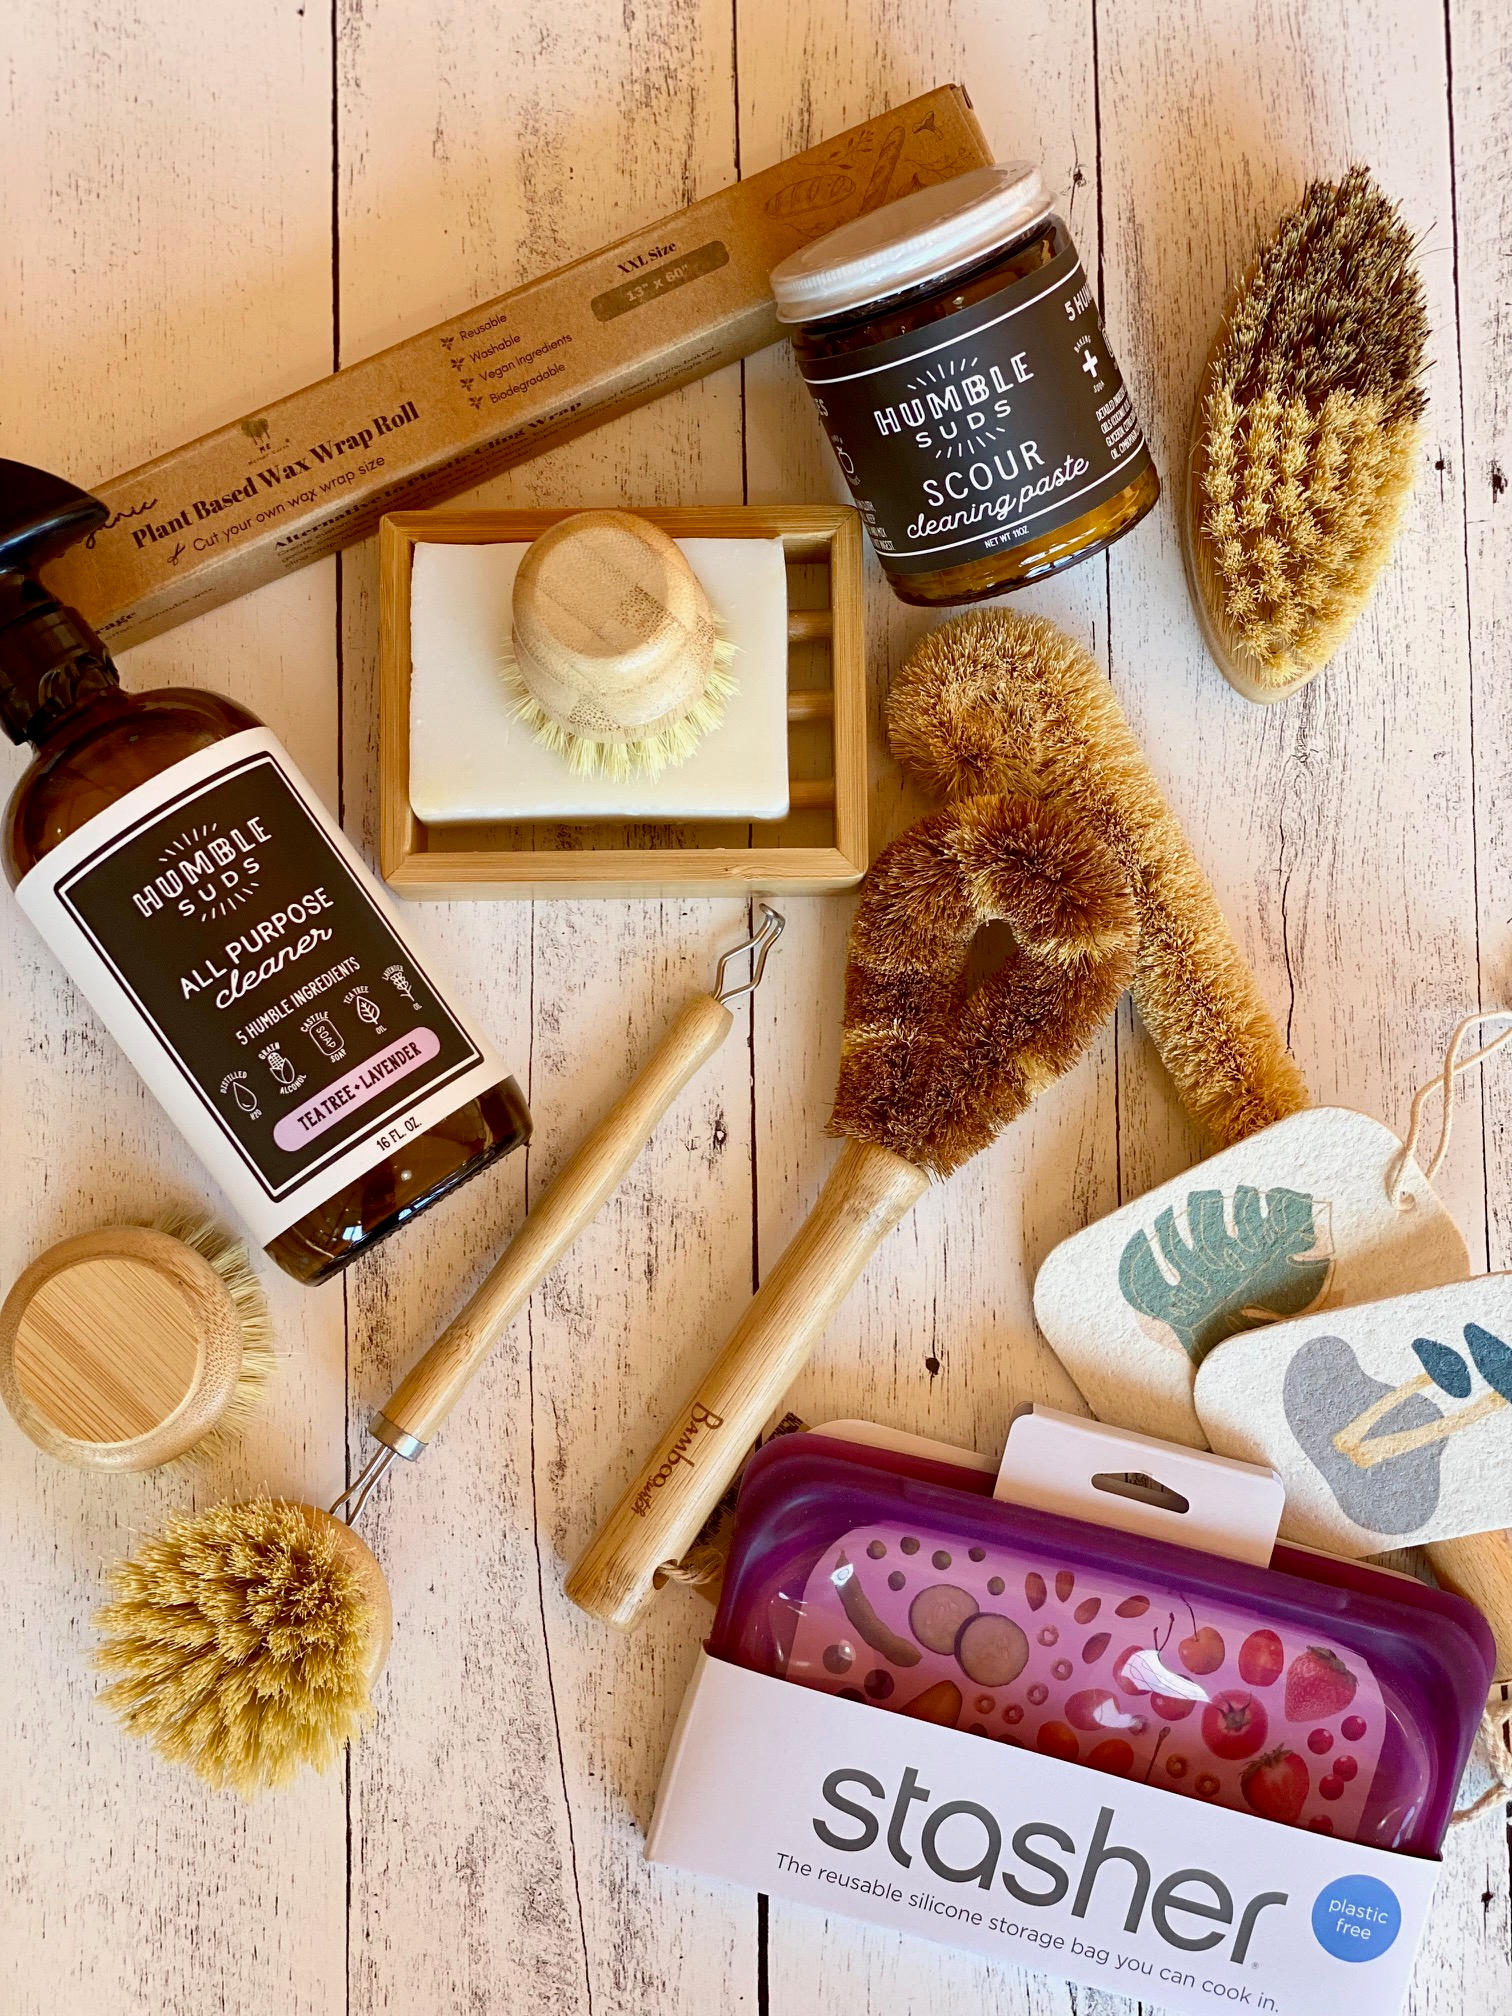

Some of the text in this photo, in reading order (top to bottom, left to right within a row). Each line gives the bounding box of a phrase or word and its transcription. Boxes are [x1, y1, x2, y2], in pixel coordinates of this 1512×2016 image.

[617, 241, 678, 276] XXL Size
[627, 281, 649, 302] 13"
[665, 264, 689, 283] 60"
[459, 313, 508, 342] Reusable
[1064, 301, 1076, 321] 5
[469, 333, 521, 363] Washable
[478, 333, 573, 384] Vegan Ingredients
[490, 362, 566, 405] Biodegradable
[874, 351, 1035, 436] HUMBLE
[916, 400, 1011, 448] SUDS
[131, 400, 420, 550] Plant Based Wax Wrap Roll
[275, 496, 382, 550] Alternative
[406, 454, 472, 488] Plastic
[474, 428, 526, 456] Cling
[528, 402, 583, 429] Wrap
[923, 440, 1045, 507] SCOUR
[193, 456, 385, 551] Cut your own wax wrap size
[907, 454, 1090, 539] cleaning paste
[984, 537, 999, 549] NET
[999, 533, 1011, 544] WT
[132, 816, 273, 918] HUMBLE
[178, 857, 261, 917] SUDS
[179, 887, 335, 1000] ALL PURPOSE
[215, 927, 333, 1010] cleaner
[381, 963, 404, 981] LAVENDER
[235, 956, 361, 1046] 5 HUMBLE INGREDIENTS
[343, 985, 370, 1005] TEA TREE
[300, 1010, 329, 1033] CASTILE
[315, 1025, 336, 1049] SOAP
[375, 1025, 387, 1035] OIL
[258, 1041, 281, 1060] GRAIN
[330, 1048, 347, 1063] SOAP
[220, 1070, 248, 1094] DISTILLED
[279, 1072, 307, 1095] ALCOHOL
[297, 1042, 422, 1131] TEA TREE LAVENDER
[376, 1116, 422, 1151] 16 FL. OZ.
[812, 1765, 1289, 1965] stasher
[1329, 1897, 1389, 1924] plastic
[1336, 1918, 1372, 1940] free
[776, 1852, 1279, 2013] The reusable silicone storage bag you can cook in.
